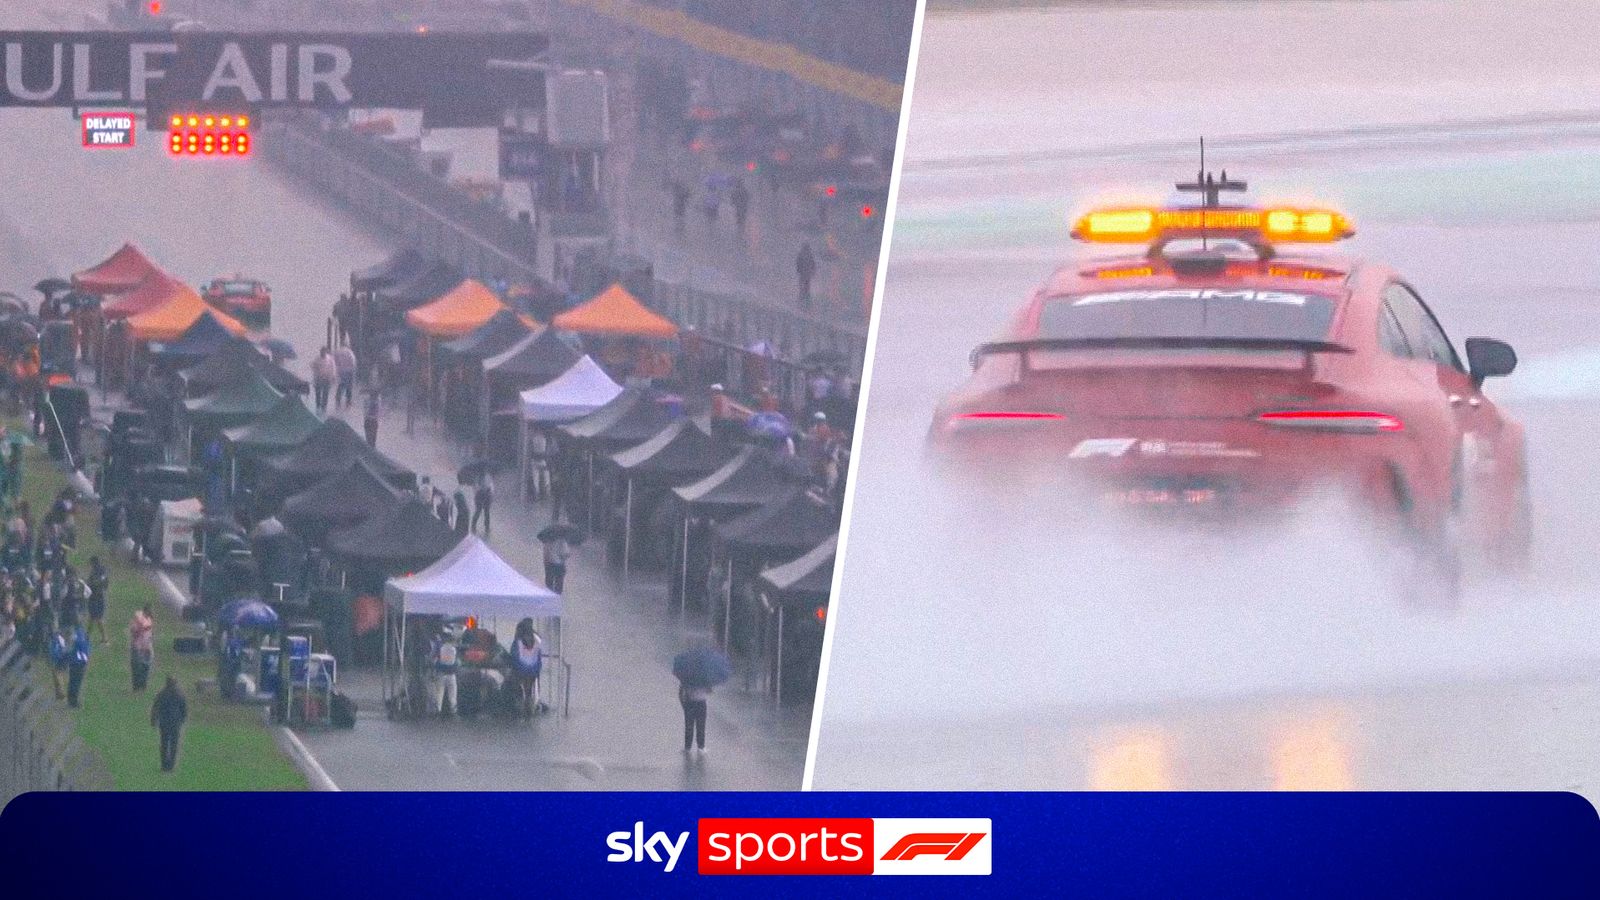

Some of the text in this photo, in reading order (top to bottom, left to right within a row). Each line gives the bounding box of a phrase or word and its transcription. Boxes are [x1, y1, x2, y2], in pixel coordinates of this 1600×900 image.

[202, 42, 354, 102] AIR
[85, 117, 131, 129] DELAYED
[92, 131, 125, 143] START
